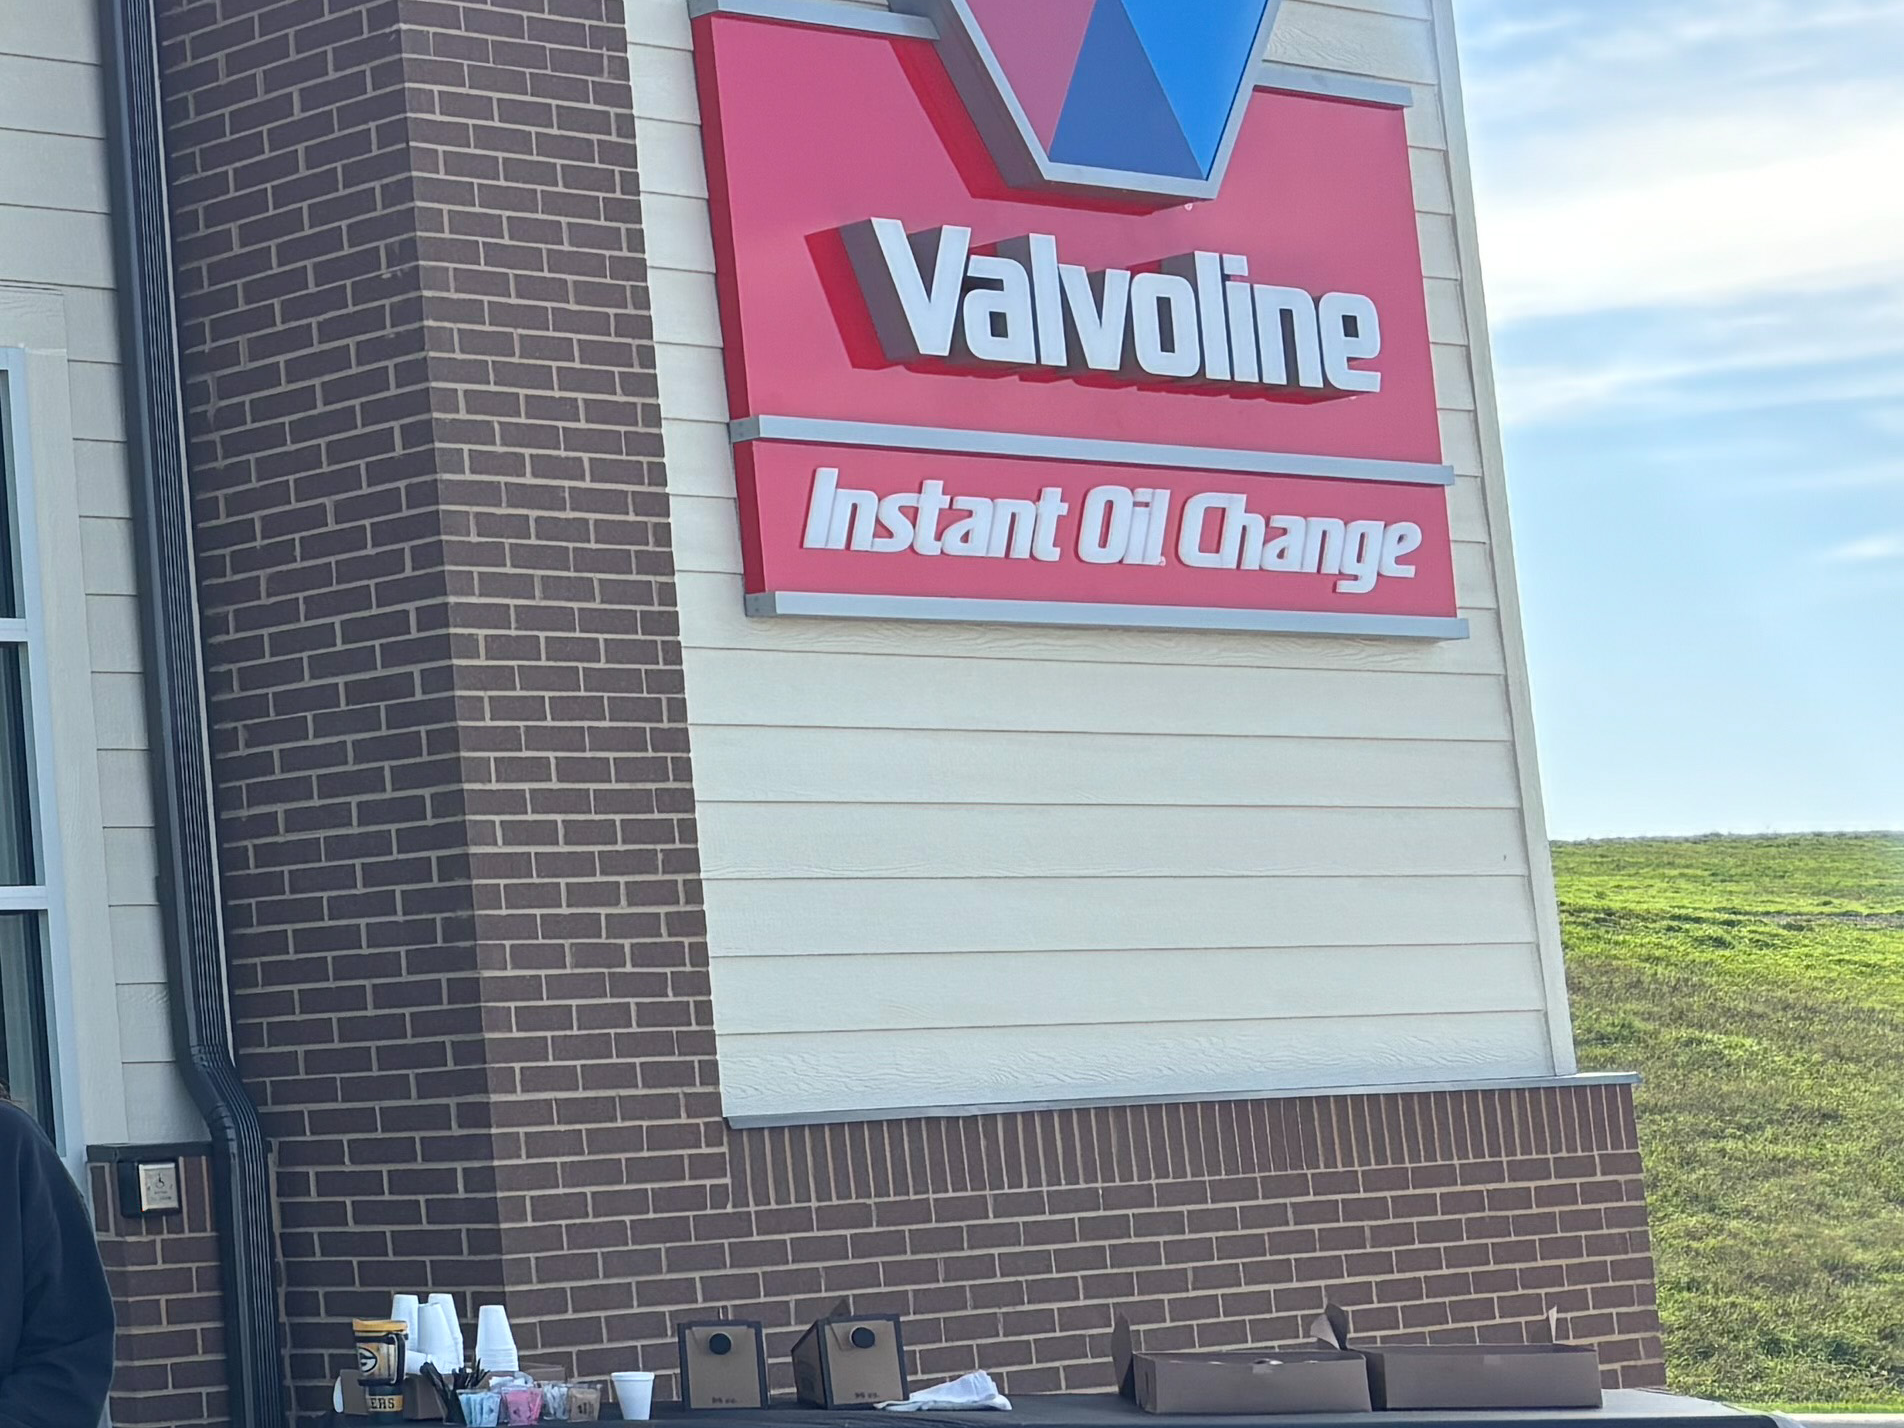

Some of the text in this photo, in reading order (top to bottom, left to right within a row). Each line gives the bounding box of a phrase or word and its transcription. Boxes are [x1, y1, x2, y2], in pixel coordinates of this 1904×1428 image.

[870, 217, 1382, 393] Valvoline
[802, 466, 1423, 593] Instant Oil Change
[370, 1398, 395, 1409] ERS
